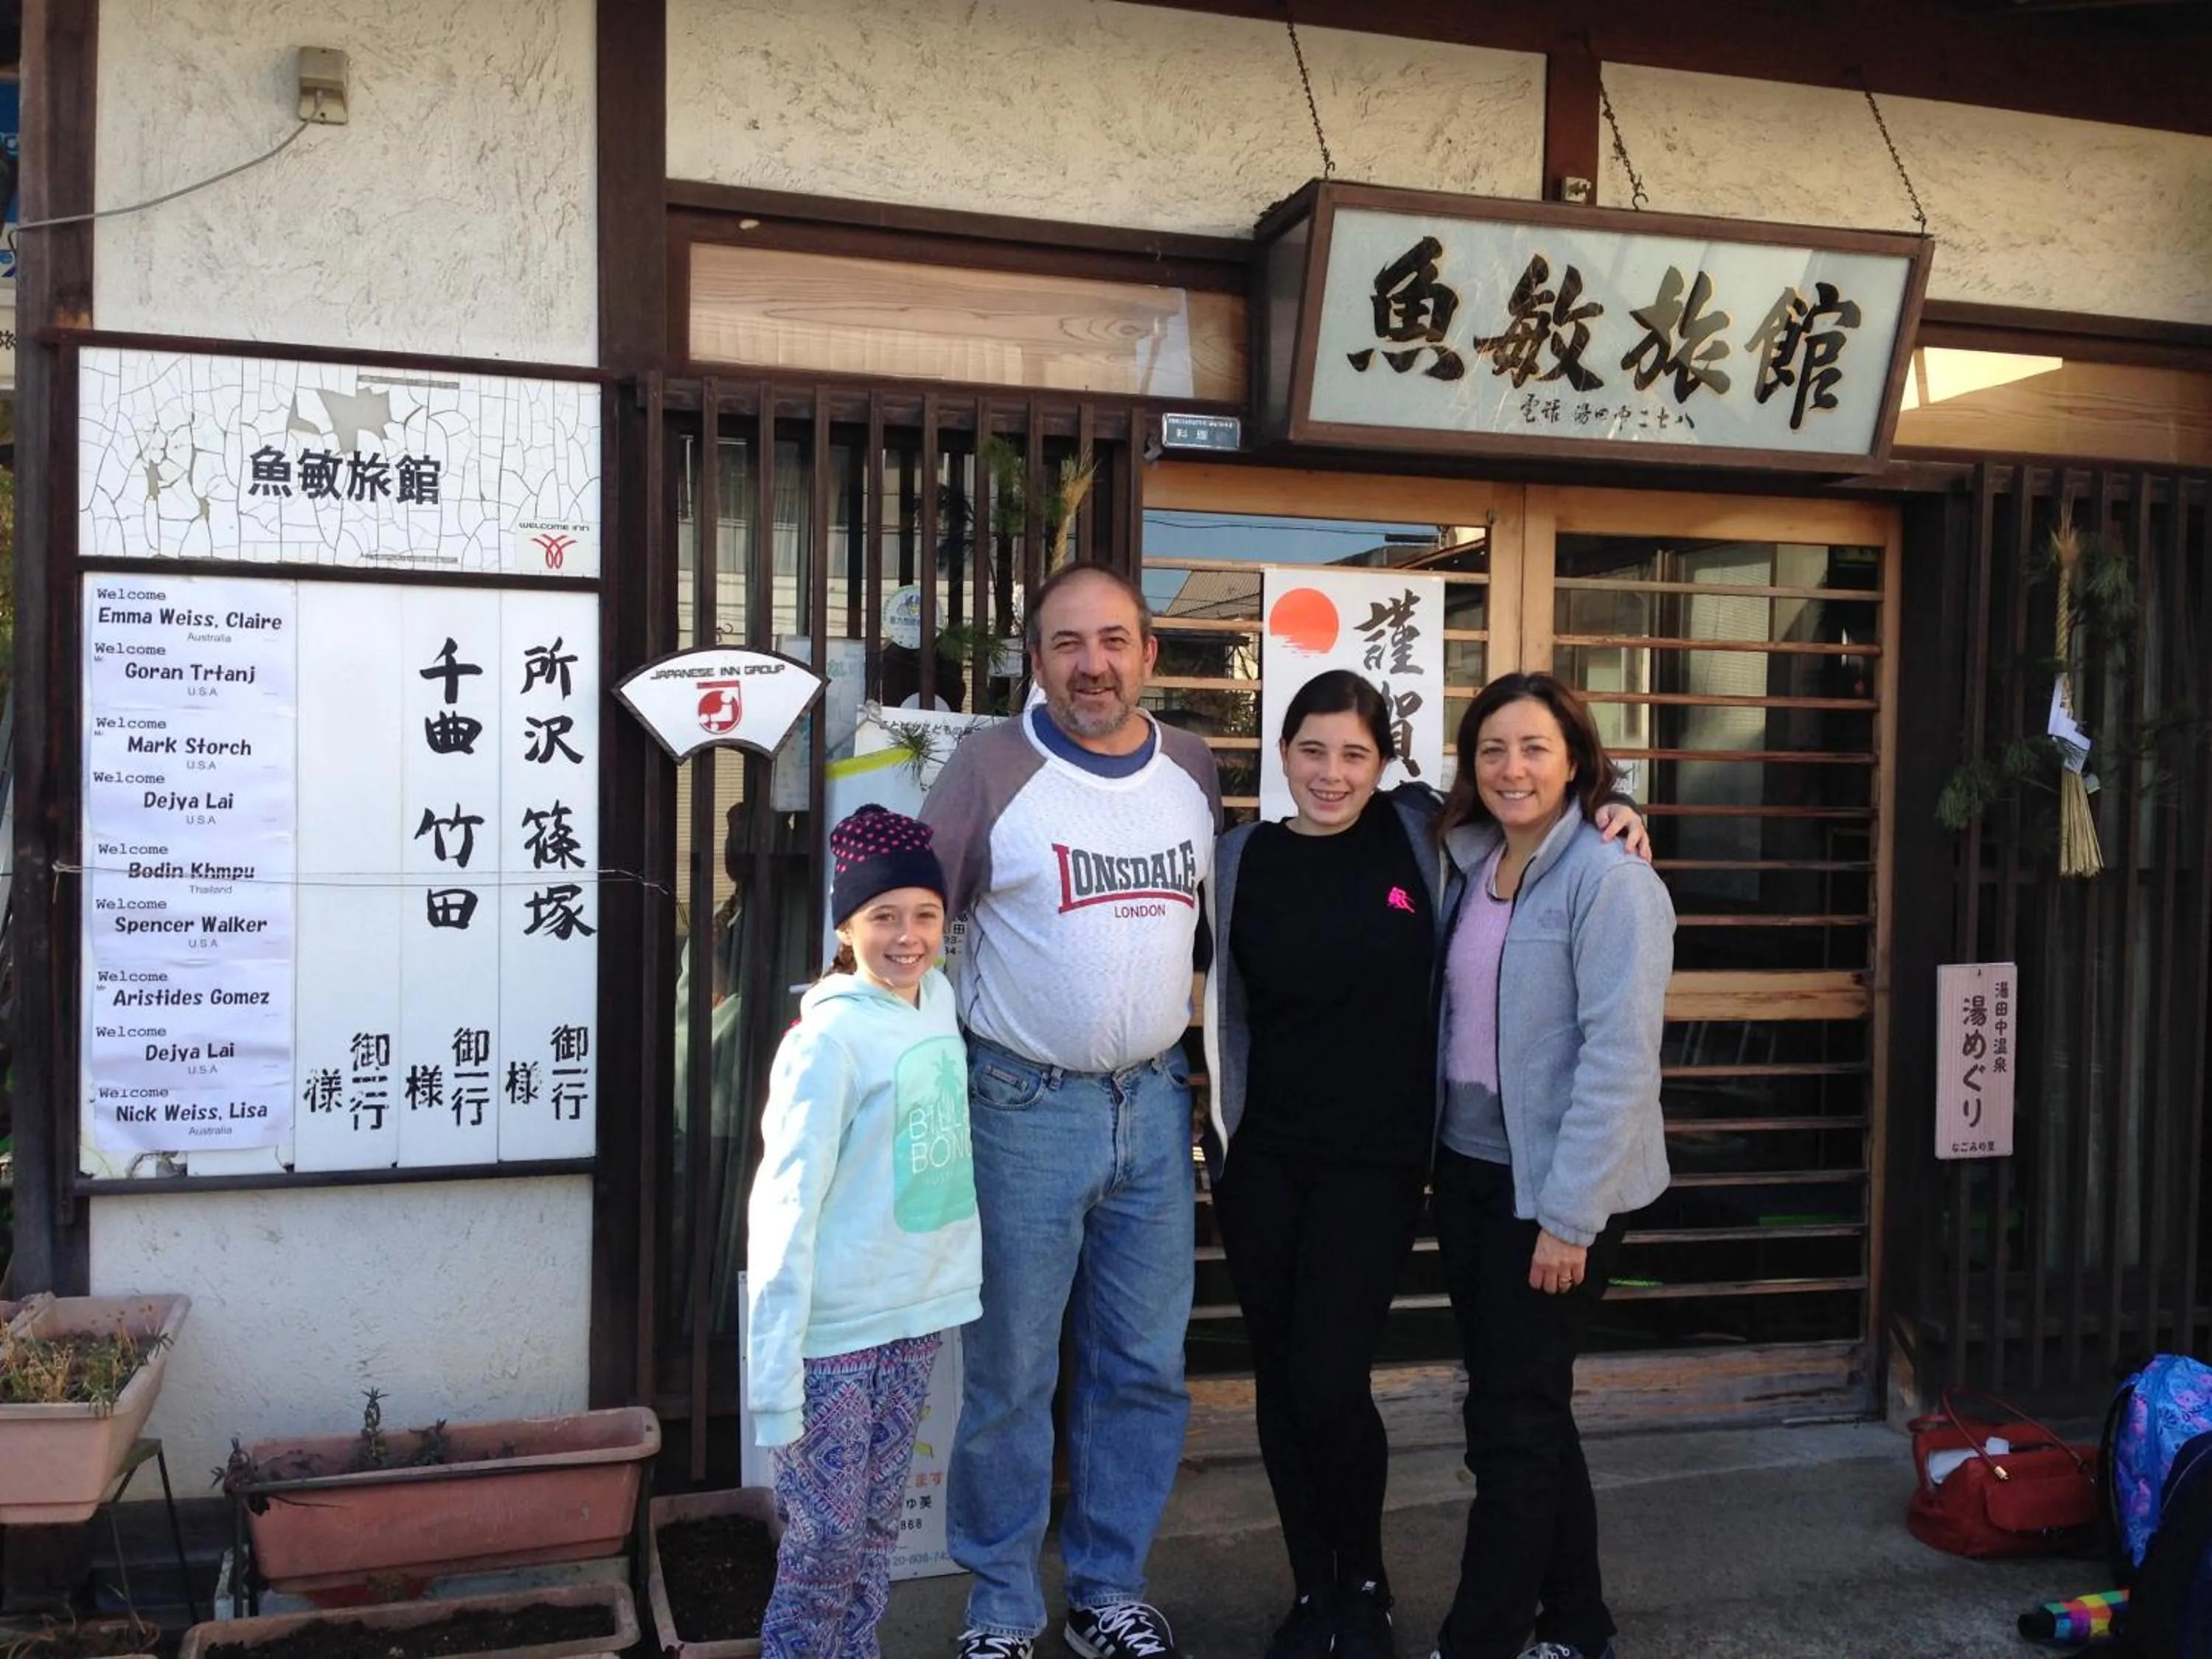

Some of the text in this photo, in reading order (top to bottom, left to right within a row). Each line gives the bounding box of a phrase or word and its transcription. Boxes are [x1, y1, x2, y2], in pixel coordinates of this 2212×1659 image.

[1347, 236, 1862, 431] 魚敏旅館
[248, 445, 441, 504] 魚敏旅館
[97, 588, 166, 601] Welcome
[98, 607, 282, 630] Emma Weiss, Claire
[187, 632, 232, 643] Australia
[94, 643, 166, 655] Welcome
[125, 662, 256, 684] Goran Trtanj
[650, 664, 785, 680] JAPANESE INN GROUP
[96, 717, 167, 729] Welcome
[128, 736, 252, 756] Mark Storch
[94, 772, 165, 784] Welcome
[144, 791, 234, 811] Dejya Lai
[98, 844, 168, 855] Welcome
[128, 862, 184, 878] Bodin
[1051, 839, 1196, 914] LONSDALE
[189, 885, 232, 894] Thailand
[96, 899, 167, 910] Welcome
[1114, 904, 1166, 918] LONDON
[115, 916, 268, 935] Spencer Walker
[98, 970, 168, 982] Welcome
[113, 988, 271, 1006] Aristides Gomez
[96, 1026, 167, 1037] Welcome
[1994, 981, 2008, 1074] 湯田中温泉
[145, 1042, 234, 1062] Dejya Lai
[1962, 995, 1987, 1127] 湯めぐり
[349, 1032, 390, 1130] 御一行
[405, 1027, 490, 1126] 御一行 様
[550, 1025, 589, 1120] 御一行
[99, 1088, 169, 1099] Welcome
[116, 1102, 268, 1122] Nick Weiss, Lisa
[189, 1126, 232, 1135] Australia
